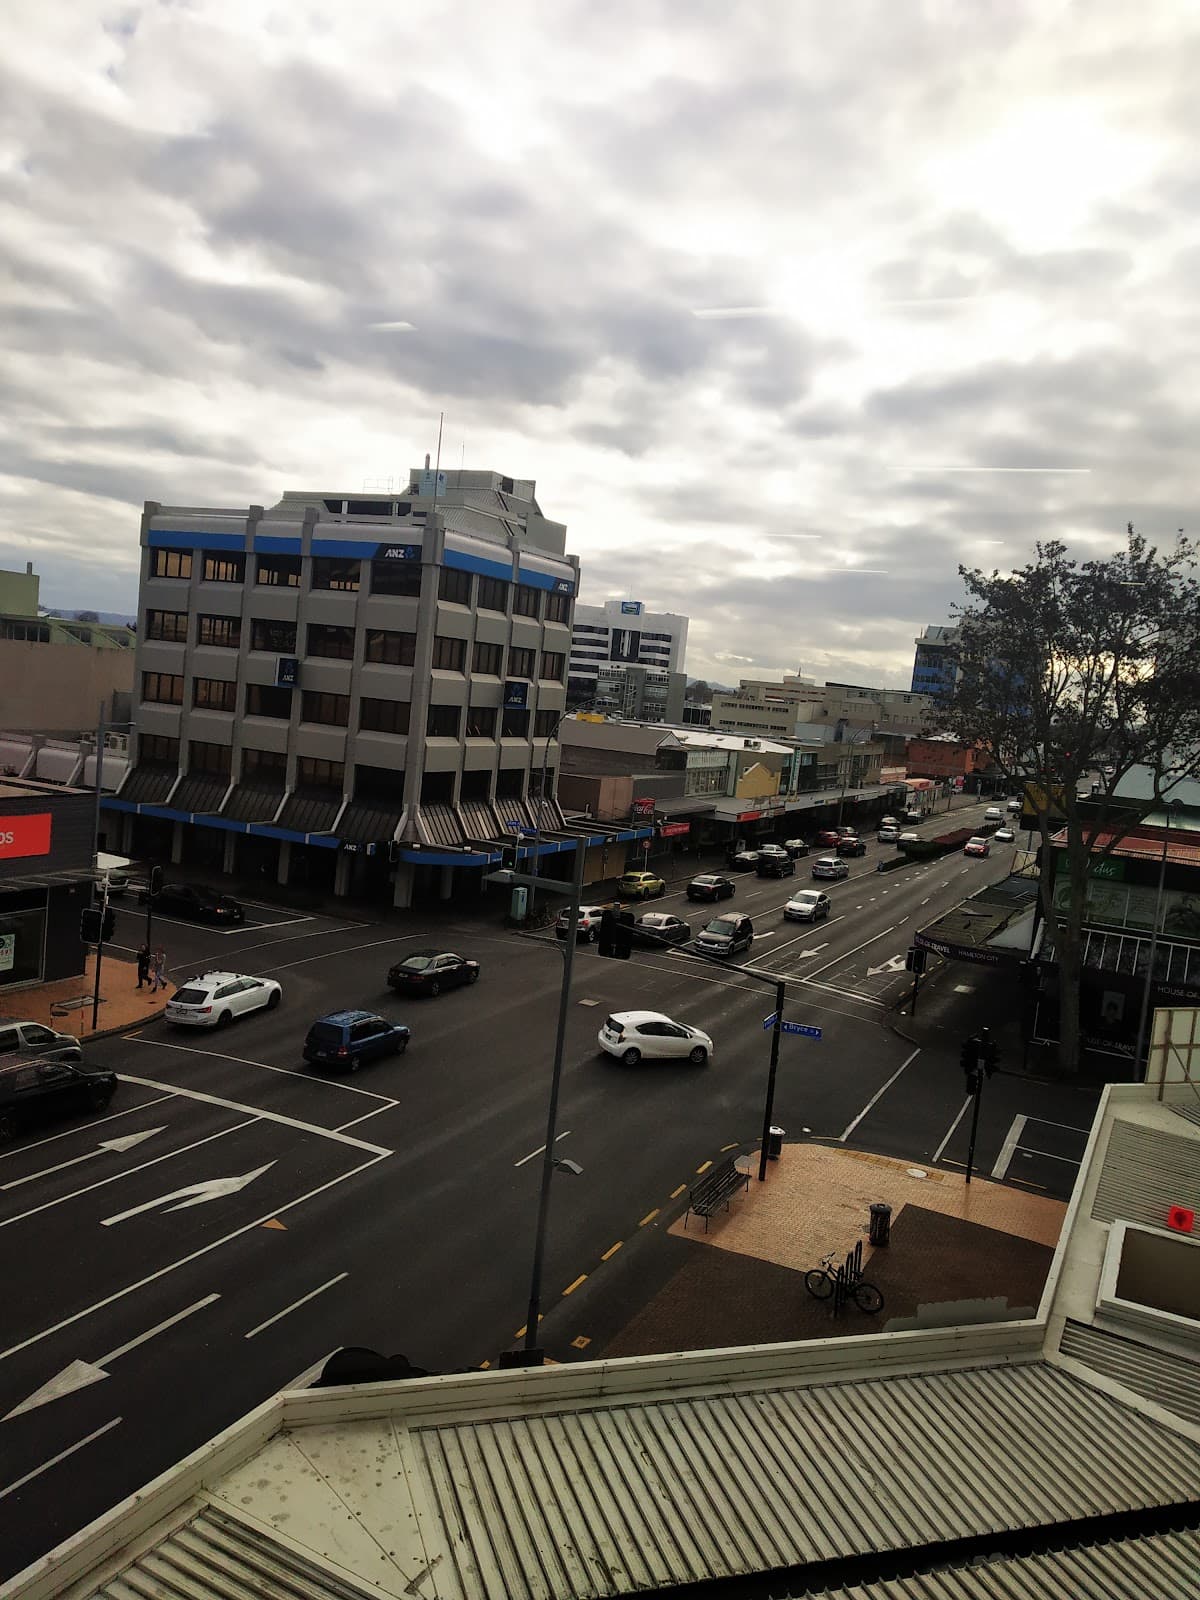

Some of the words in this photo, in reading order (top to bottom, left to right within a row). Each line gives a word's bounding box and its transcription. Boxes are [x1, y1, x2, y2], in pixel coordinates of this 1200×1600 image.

[384, 548, 405, 559] ANZ
[1157, 986, 1184, 997] HOUSE
[789, 1023, 809, 1033] Bryce
